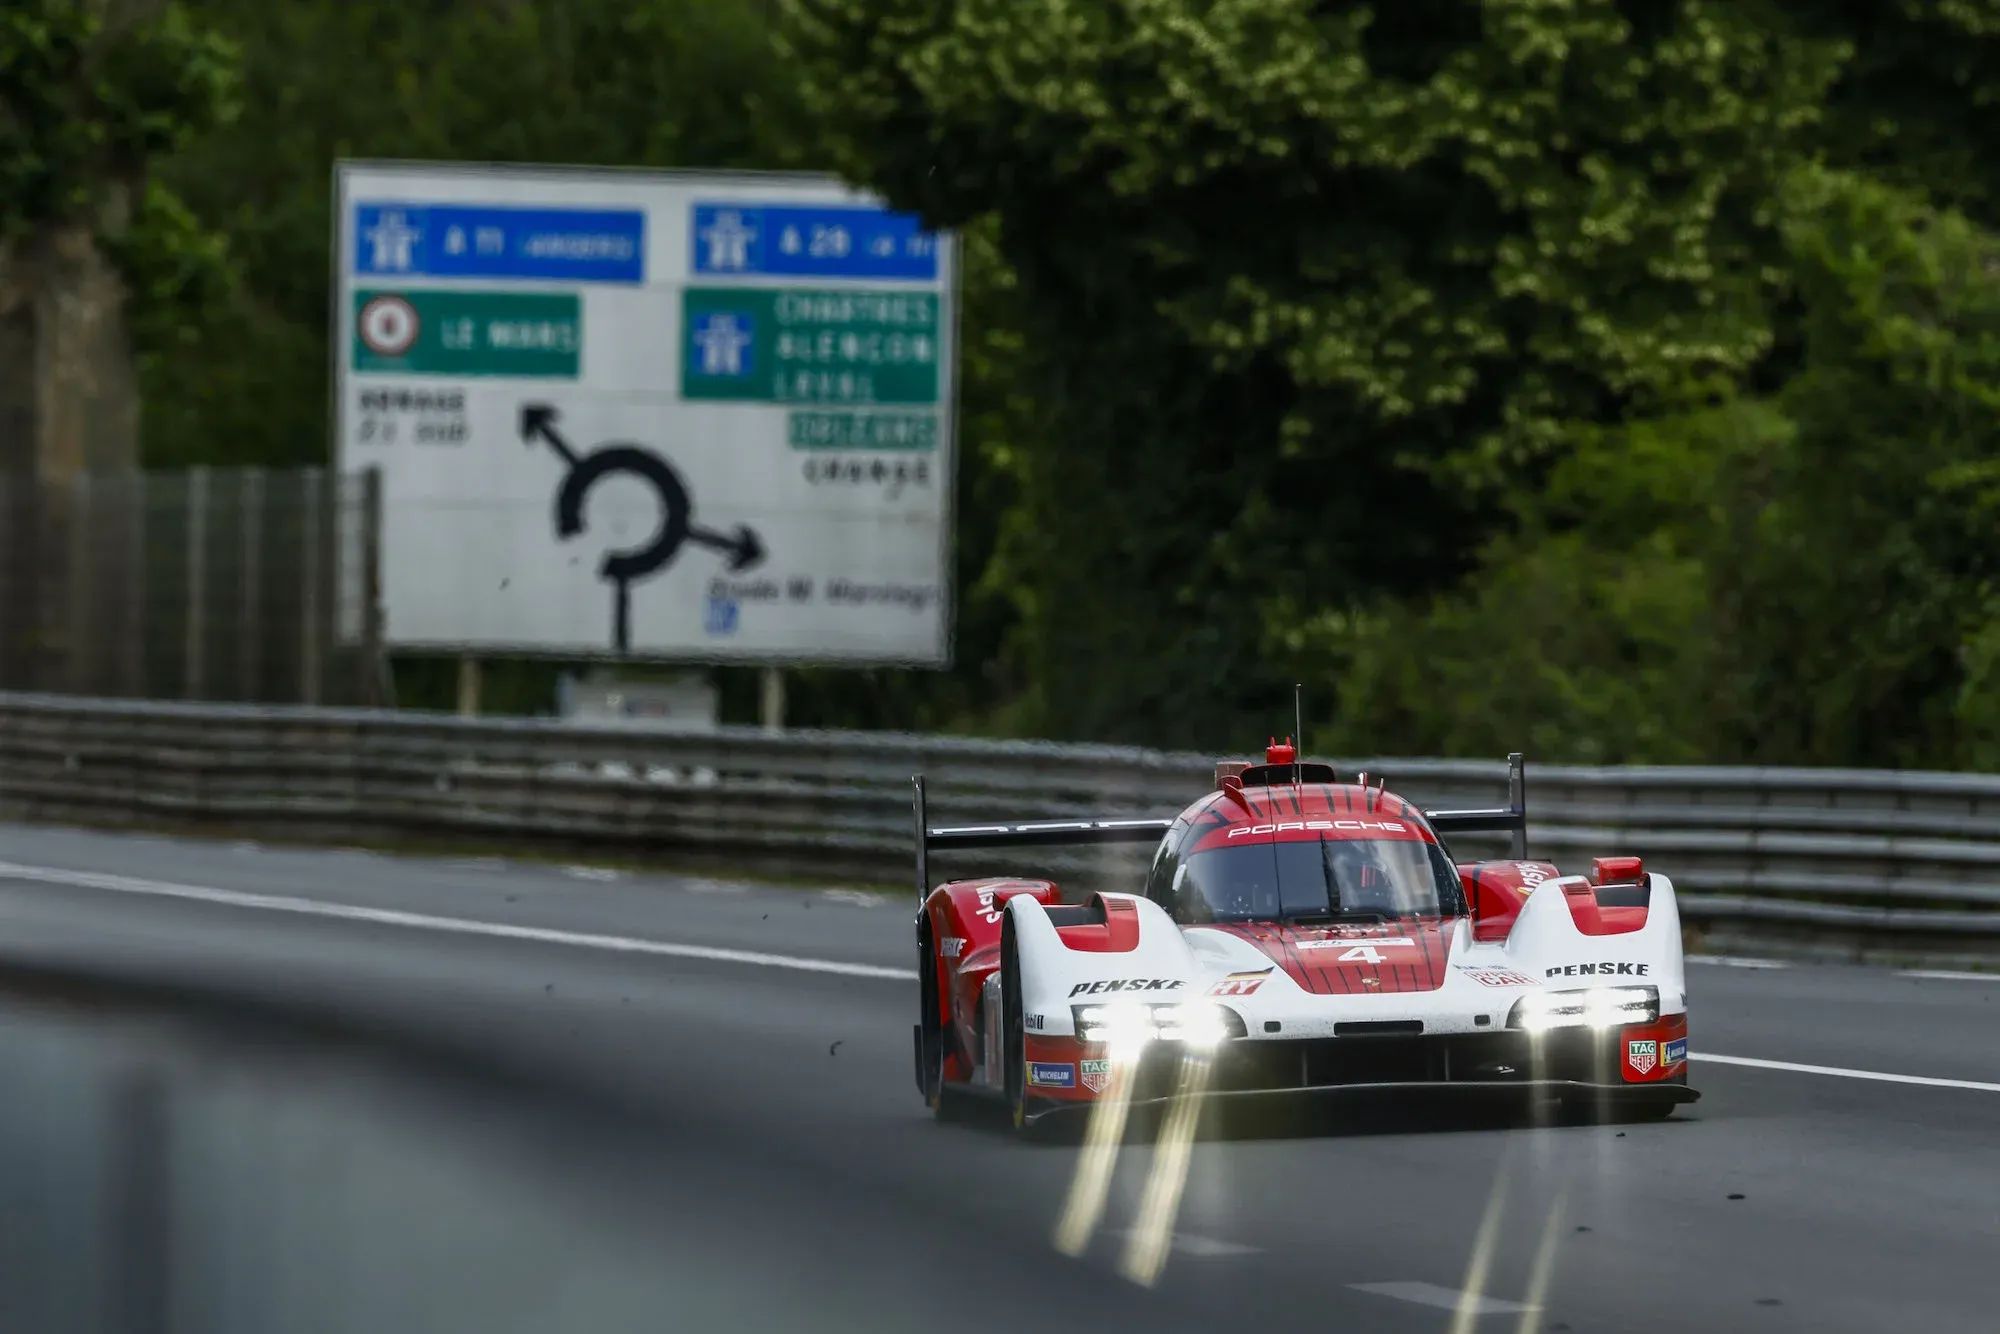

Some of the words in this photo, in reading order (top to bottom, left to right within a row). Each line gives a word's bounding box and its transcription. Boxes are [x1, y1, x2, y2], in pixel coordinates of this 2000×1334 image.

[1227, 820, 1407, 839] PORSCHE
[1338, 946, 1387, 964] 4
[1545, 962, 1649, 977] PENSKE
[1068, 978, 1187, 998] PENSKE
[1632, 1043, 1655, 1053] TAG
[1083, 1062, 1109, 1073] TAG
[1631, 1056, 1655, 1072] HEUER
[1040, 1071, 1070, 1081] MICHELIN
